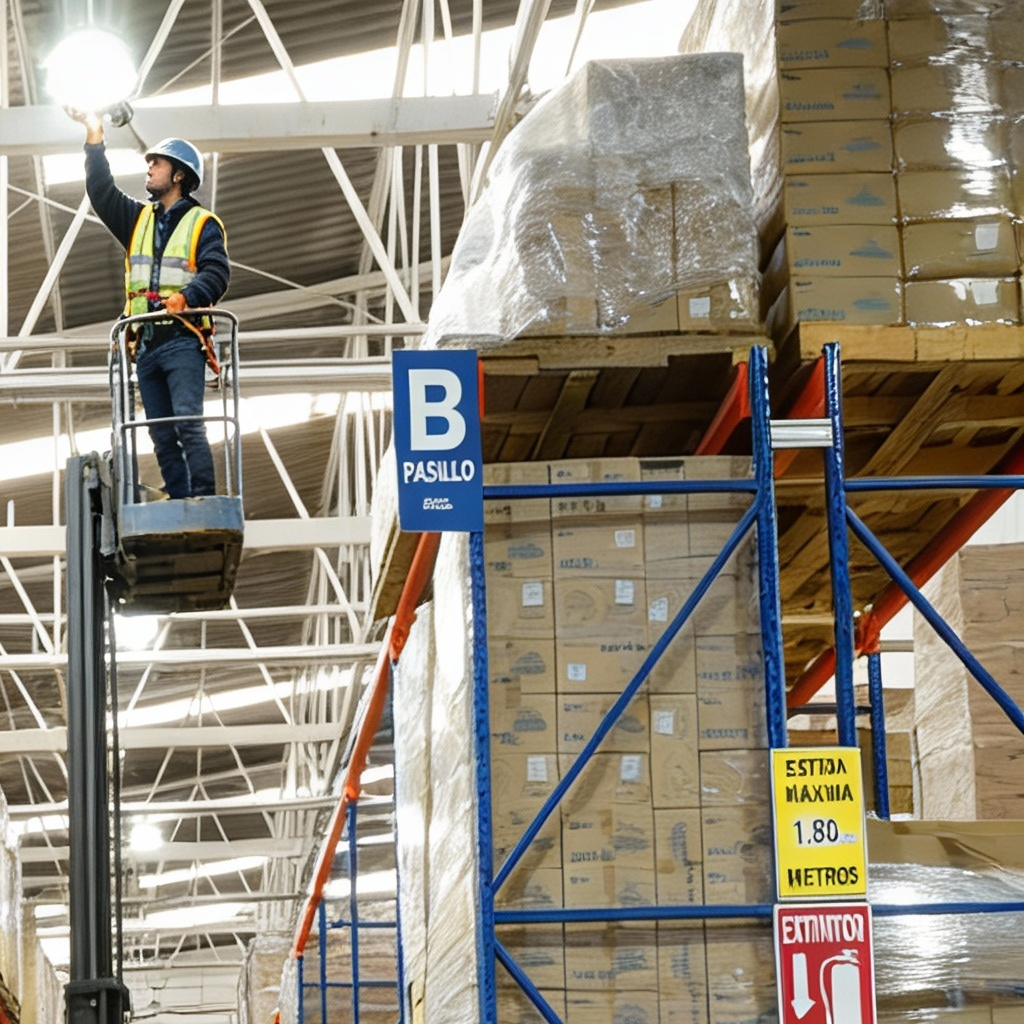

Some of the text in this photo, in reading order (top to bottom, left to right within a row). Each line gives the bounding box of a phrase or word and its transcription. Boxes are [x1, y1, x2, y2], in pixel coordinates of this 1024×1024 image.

[408, 368, 466, 451] B
[403, 459, 475, 484] PASILLO
[793, 819, 839, 844] 1.80
